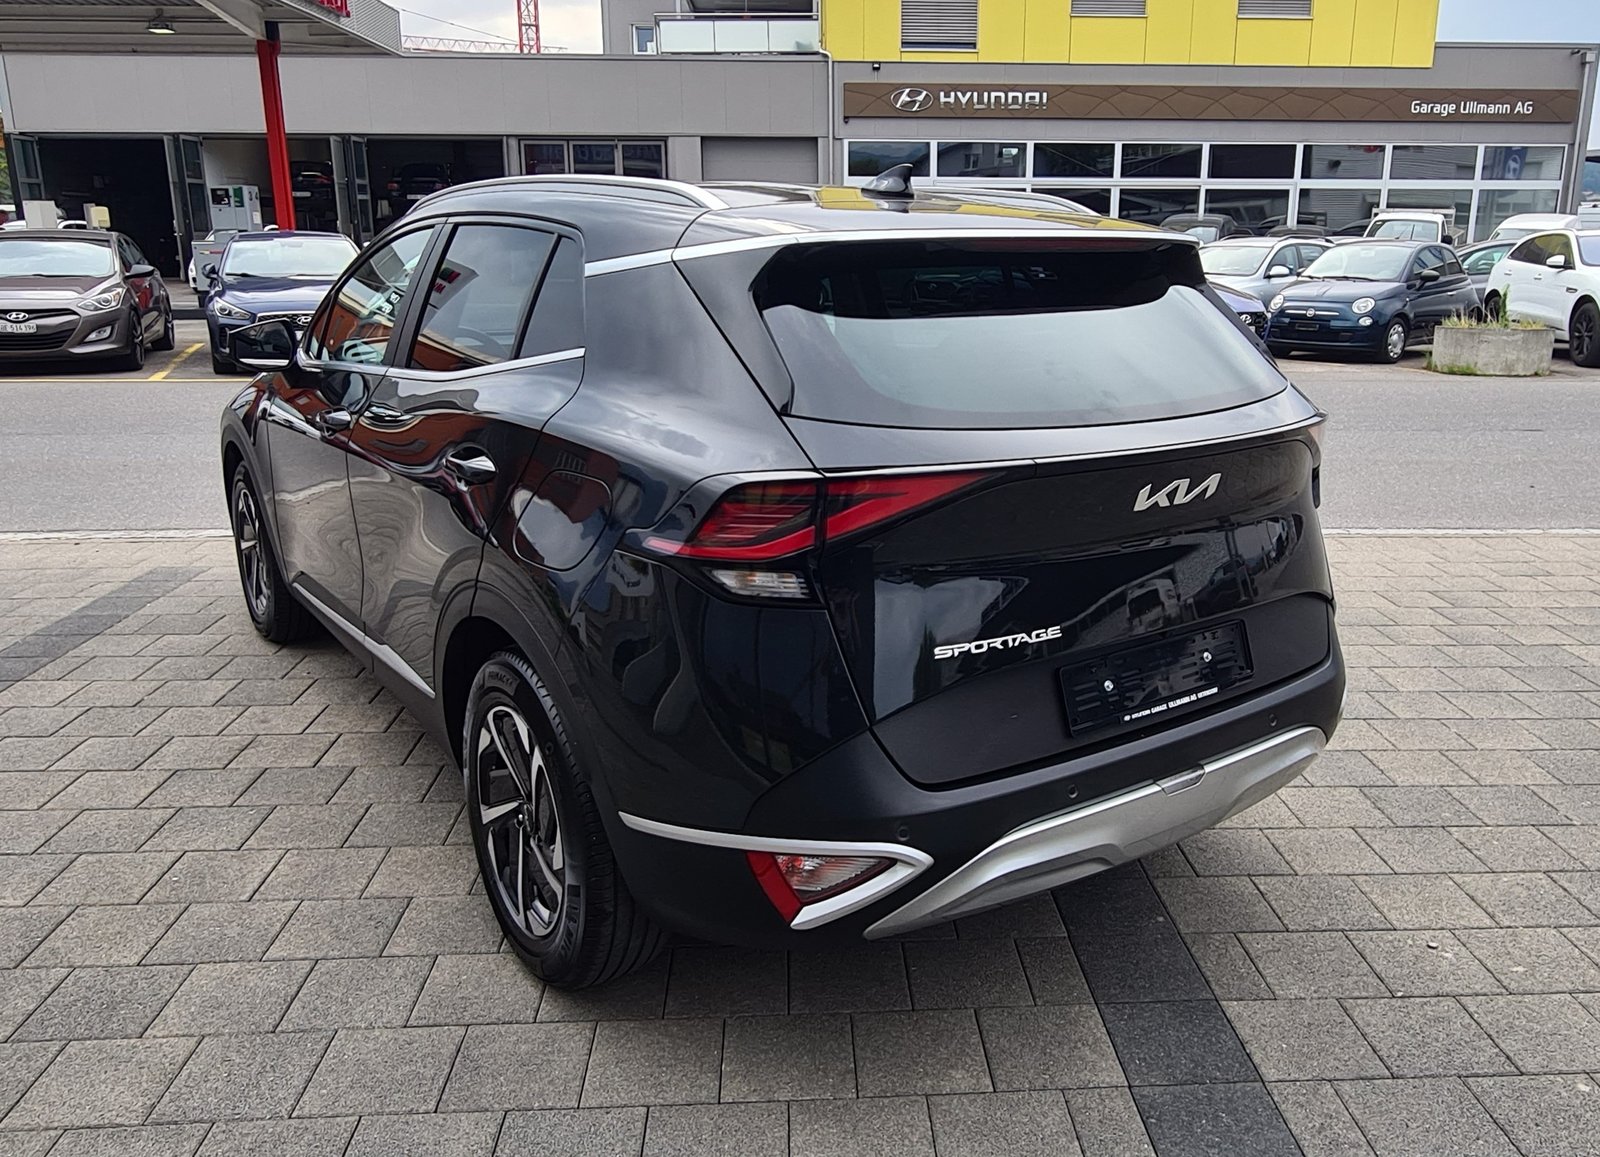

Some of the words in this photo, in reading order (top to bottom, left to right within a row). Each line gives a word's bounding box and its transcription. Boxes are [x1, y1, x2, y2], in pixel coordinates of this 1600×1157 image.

[939, 91, 1048, 109] HYUNDAI
[1411, 100, 1456, 117] Garage
[1460, 101, 1511, 114] Ullmann
[1514, 101, 1534, 115] AG
[1133, 472, 1221, 512] KIA
[933, 625, 1062, 659] SPORTAGE
